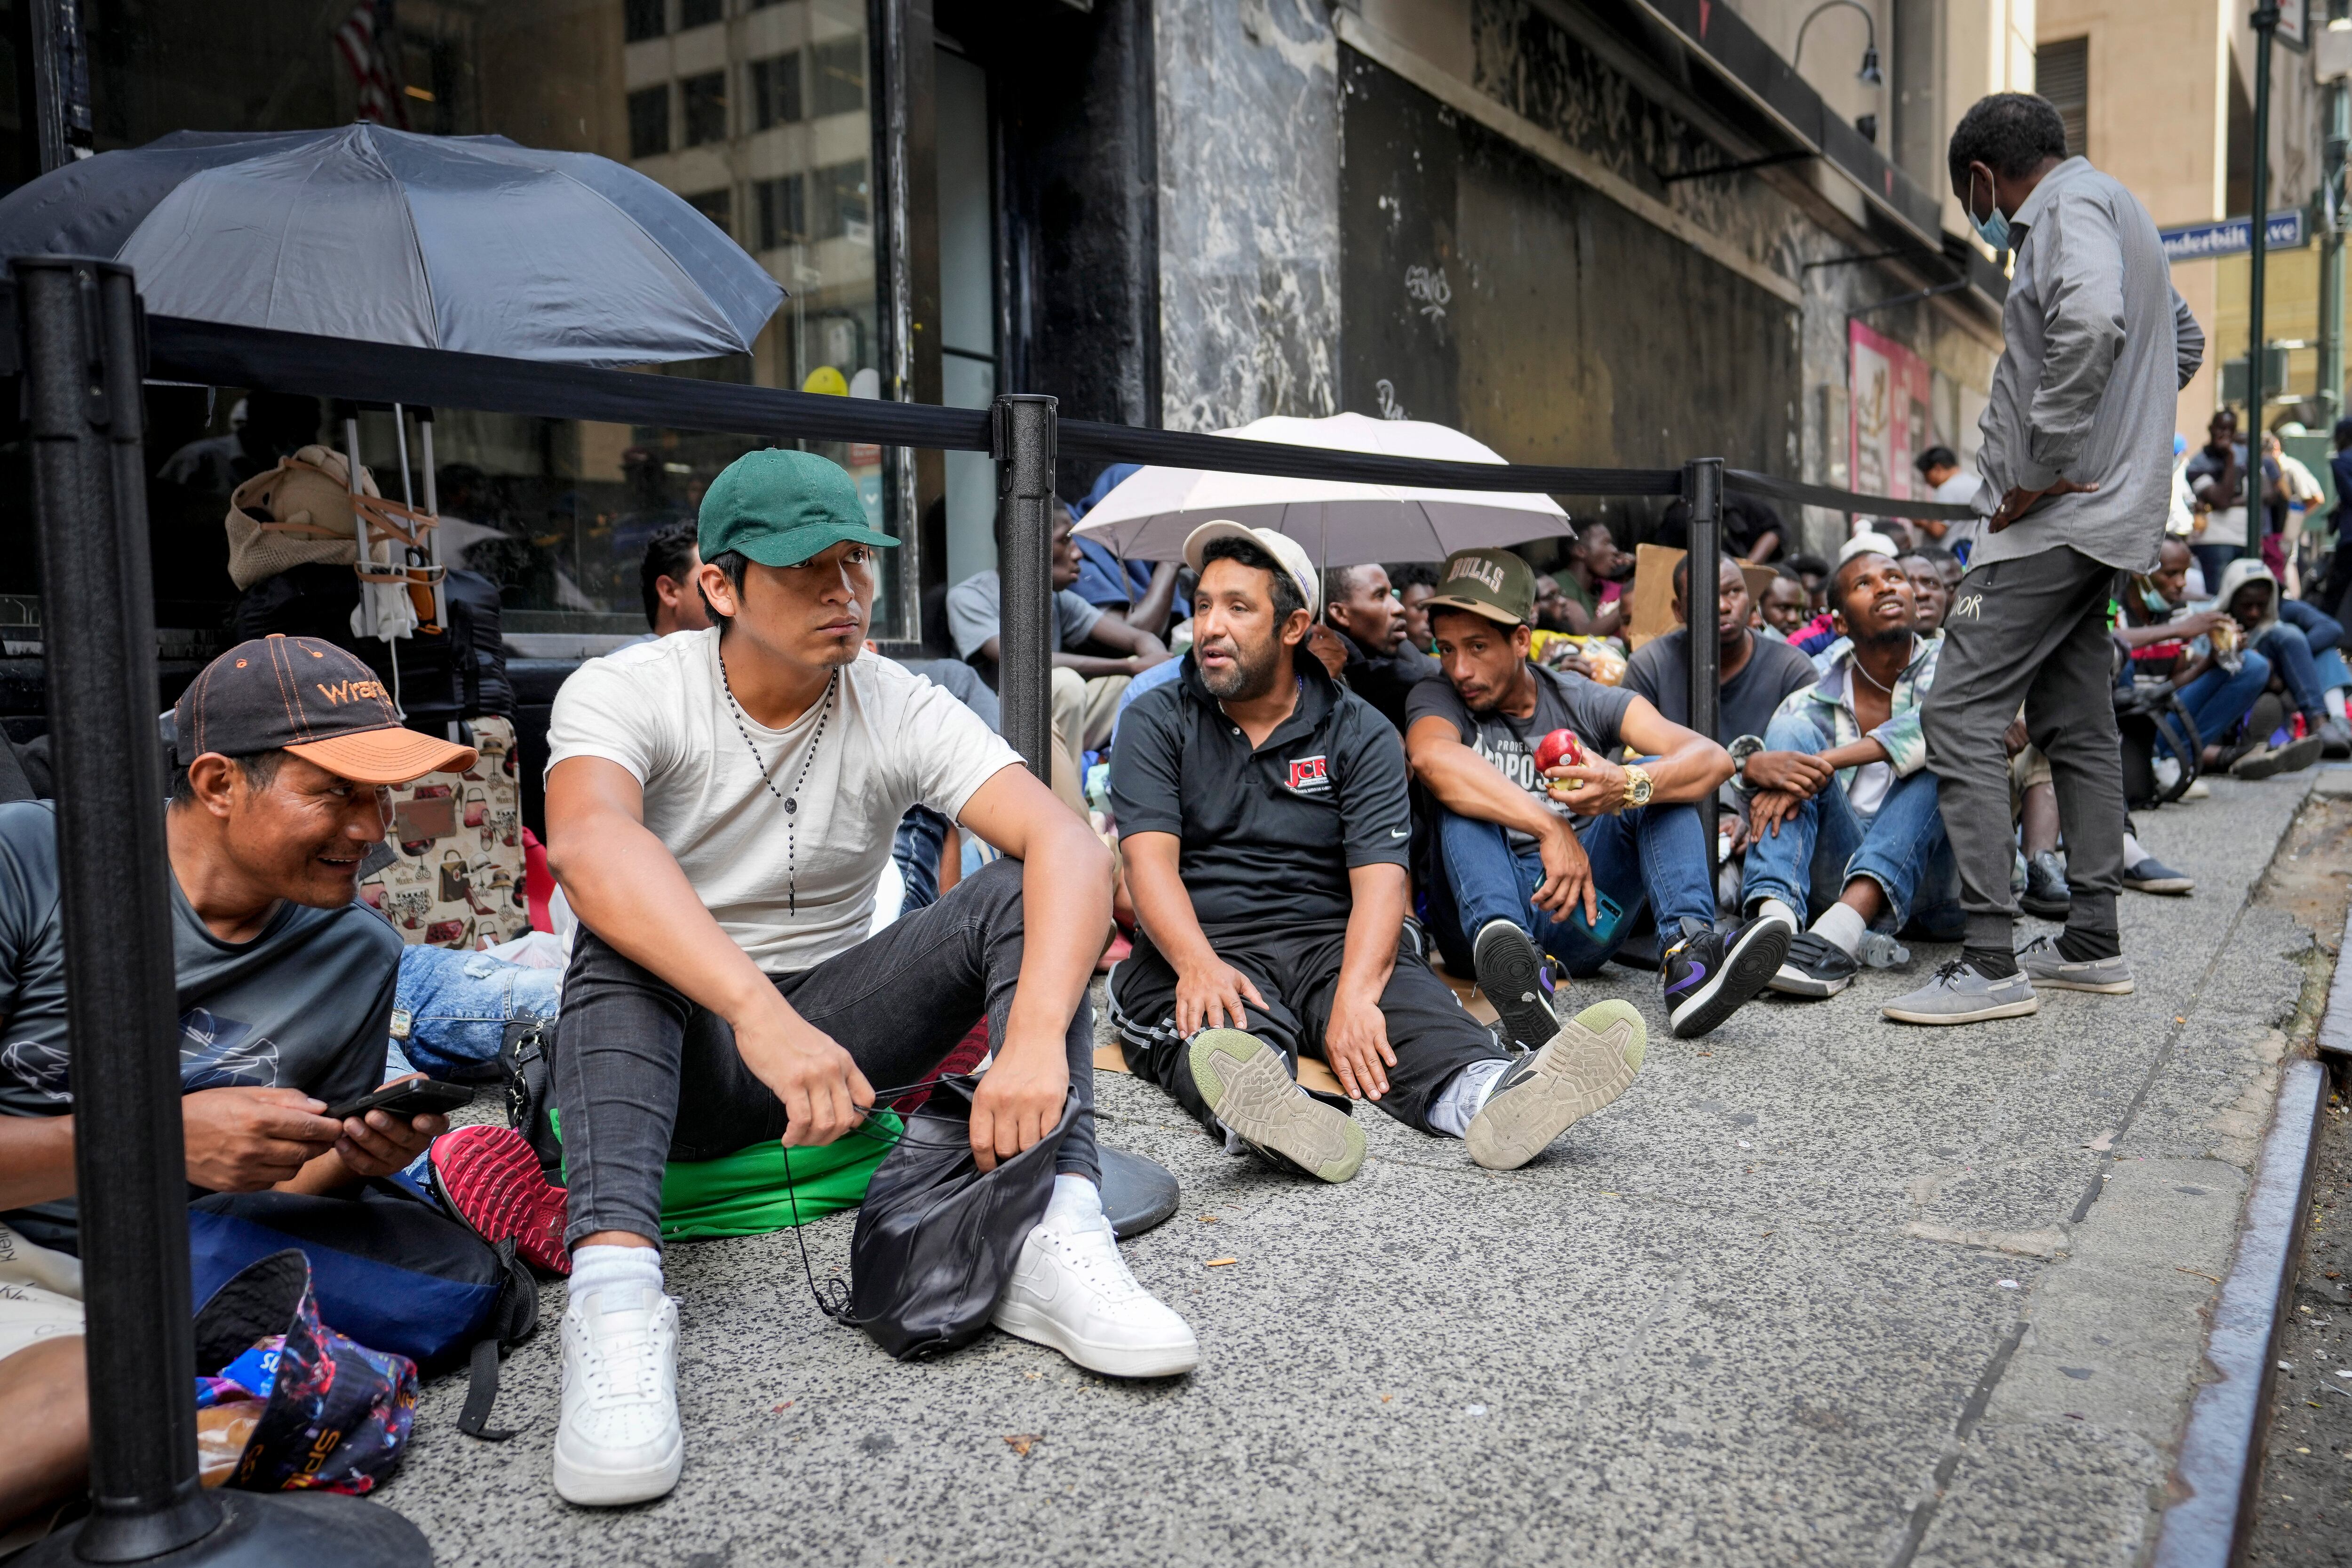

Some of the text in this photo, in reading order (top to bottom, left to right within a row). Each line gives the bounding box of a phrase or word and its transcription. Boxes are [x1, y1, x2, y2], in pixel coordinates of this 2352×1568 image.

[2162, 225, 2247, 256] nderbilt
[1447, 557, 1505, 594] BULLS
[1284, 759, 1327, 788] JCR
